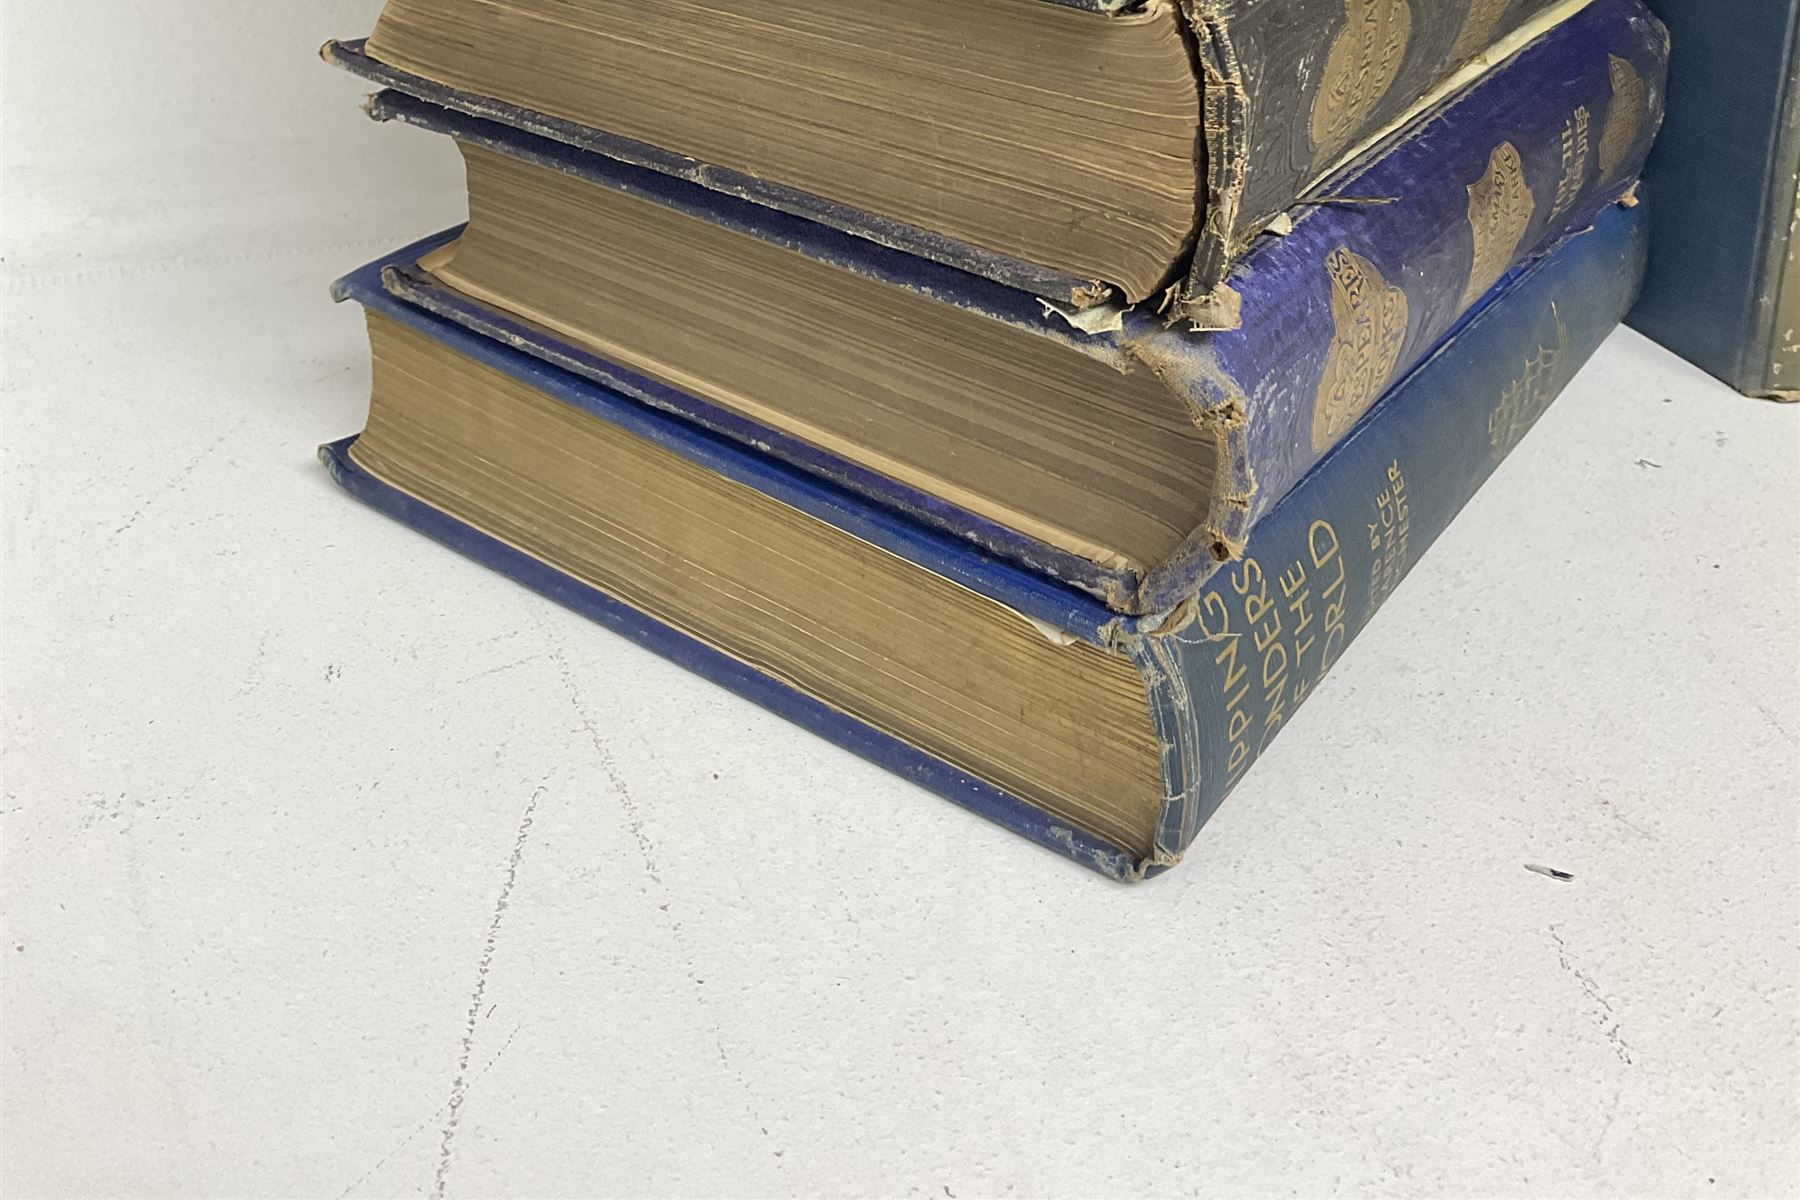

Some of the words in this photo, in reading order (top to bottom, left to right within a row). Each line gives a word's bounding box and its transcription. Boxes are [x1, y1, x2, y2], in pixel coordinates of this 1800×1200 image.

[1307, 518, 1347, 682] ORLD
[1366, 522, 1382, 551] BY
[1231, 556, 1290, 757] ONDERS
[1277, 558, 1317, 668] THE
